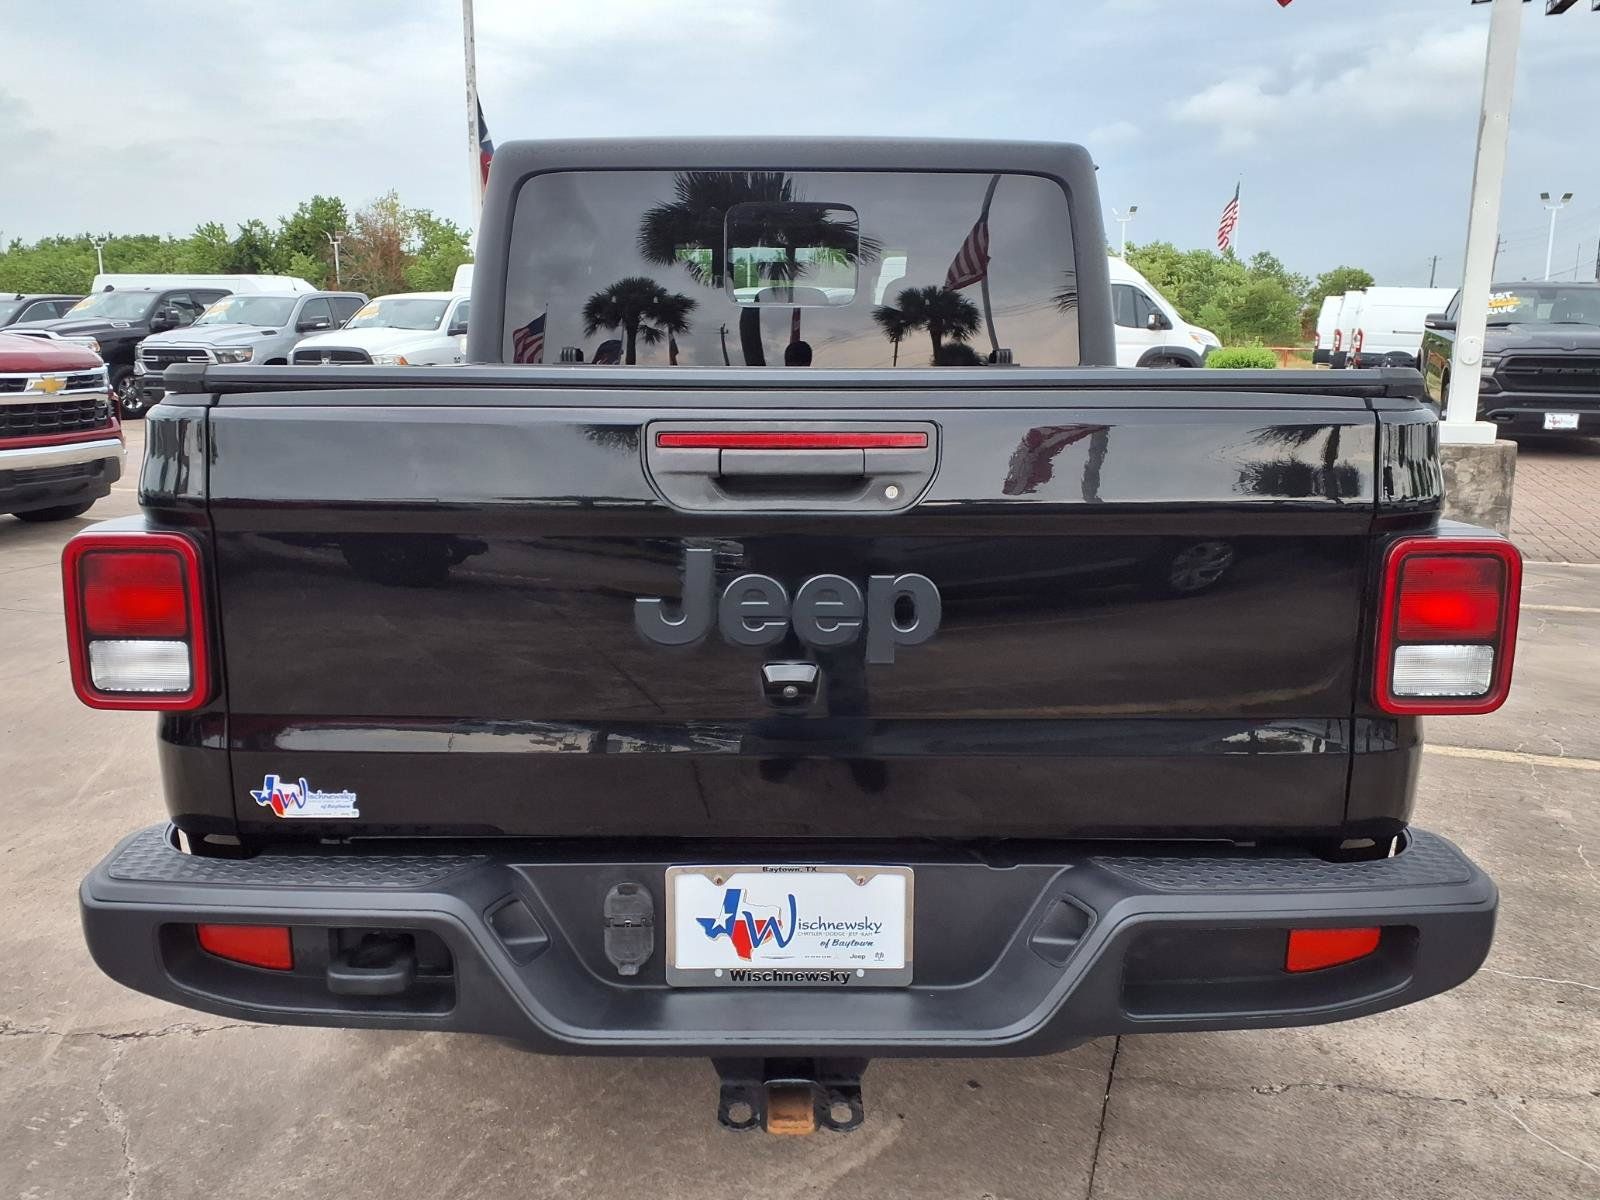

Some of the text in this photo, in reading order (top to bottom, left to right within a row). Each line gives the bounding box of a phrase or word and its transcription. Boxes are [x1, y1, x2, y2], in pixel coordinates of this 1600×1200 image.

[635, 547, 942, 664] Jeep
[742, 893, 882, 949] Wischnewsky
[820, 938, 875, 949] of Baytown
[730, 969, 851, 984] Wischnewsky
